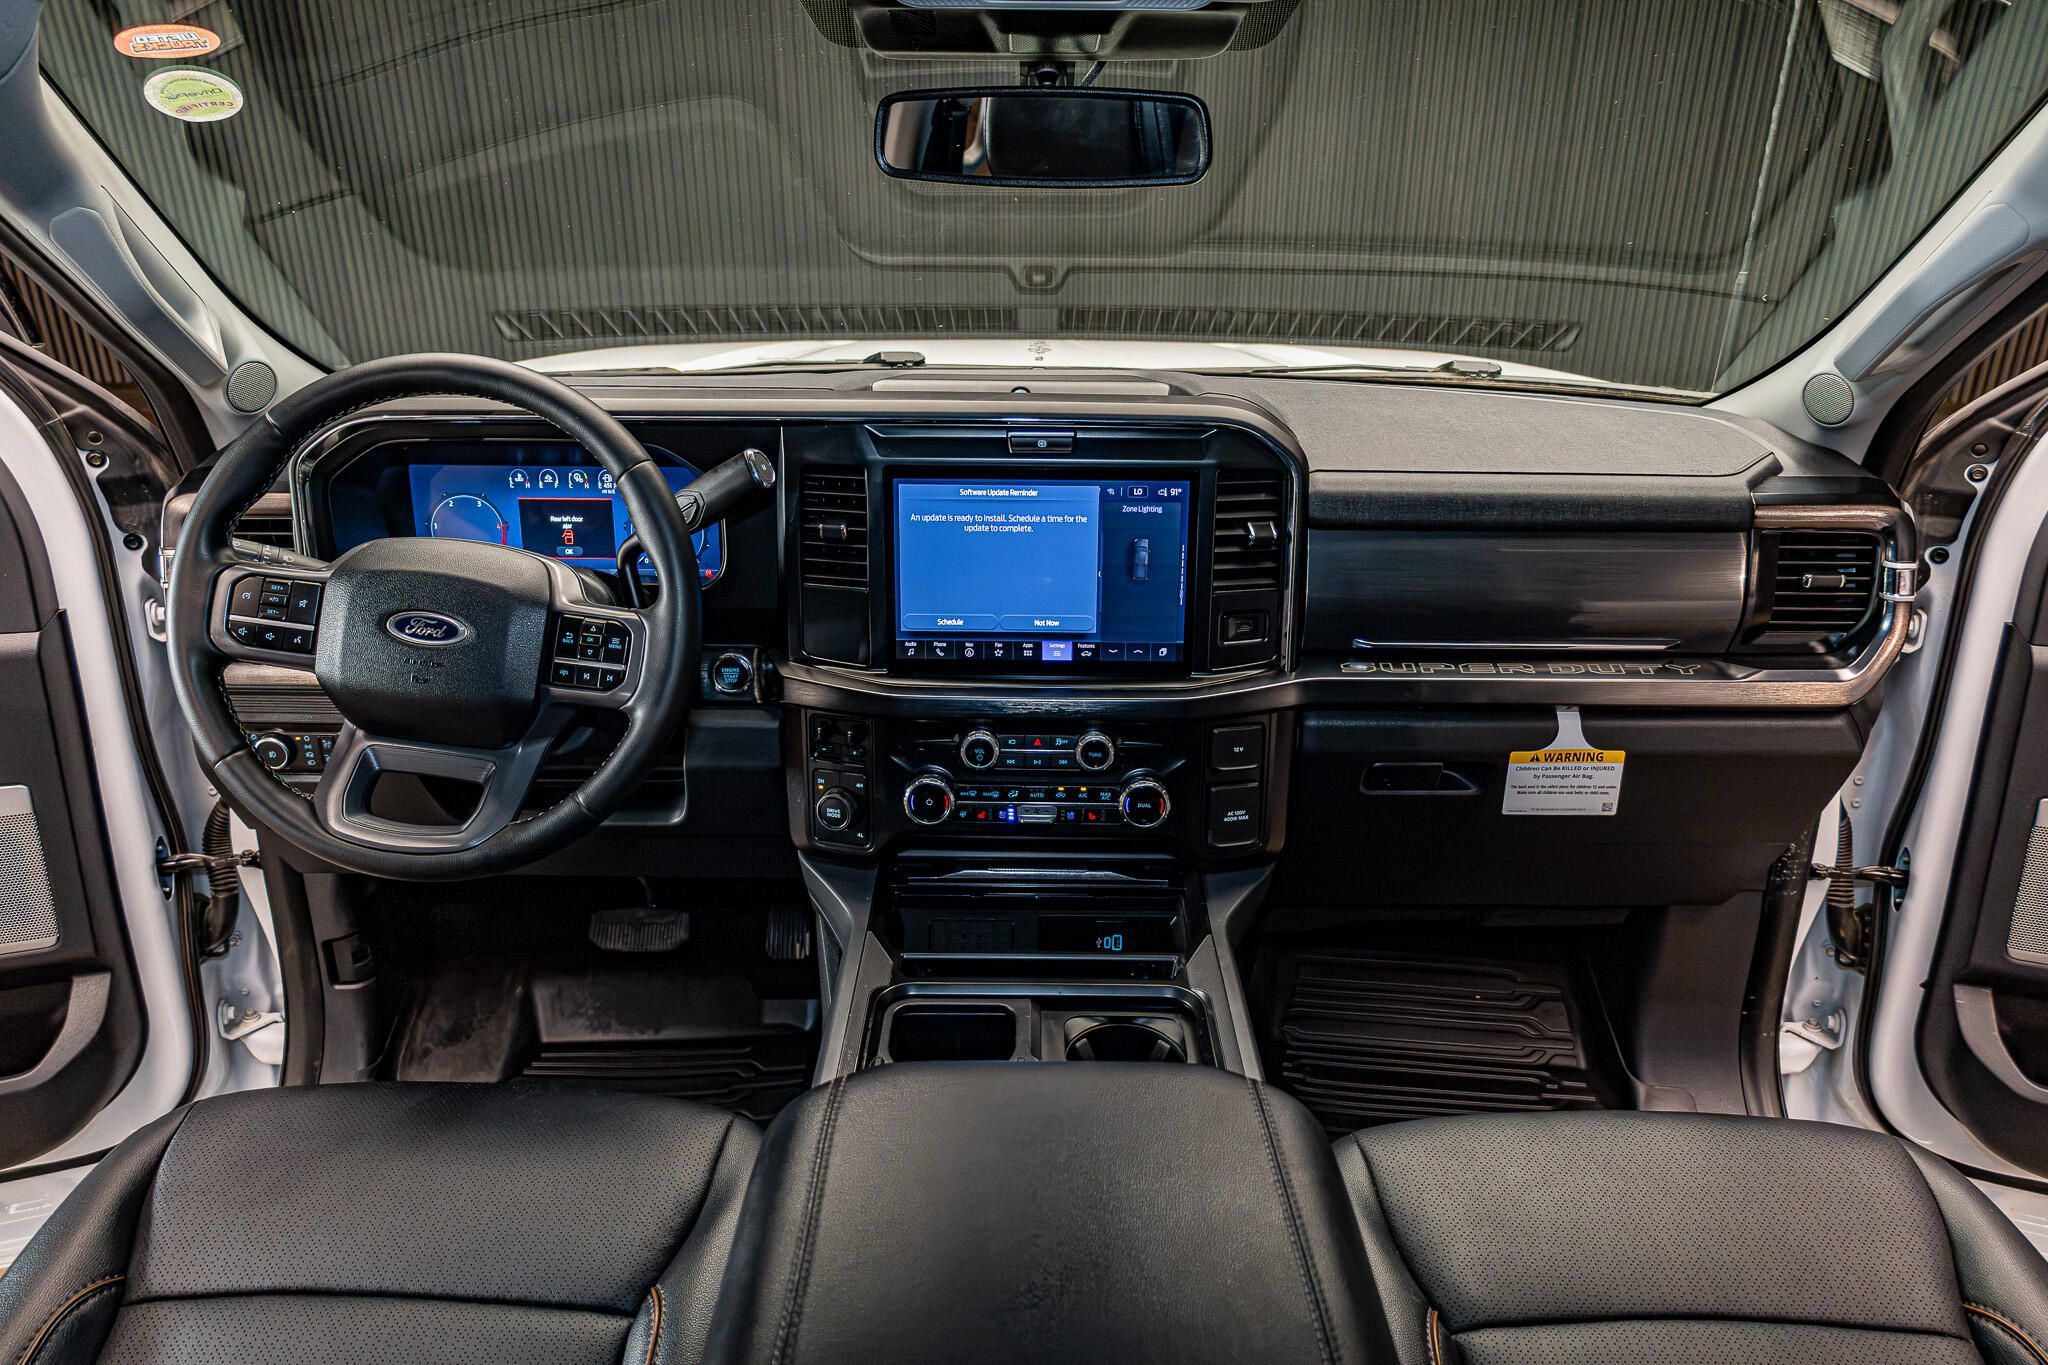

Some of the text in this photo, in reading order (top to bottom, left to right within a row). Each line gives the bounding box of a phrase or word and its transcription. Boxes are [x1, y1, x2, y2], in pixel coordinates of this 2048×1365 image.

[959, 488, 1038, 497] Software Update Reminder
[1170, 488, 1182, 496] 91°
[1122, 505, 1163, 513] Zone Lighting
[910, 513, 921, 521] An
[921, 513, 947, 523] update
[947, 514, 953, 522] is
[954, 514, 974, 523] ready
[983, 514, 1007, 522] install.
[1008, 514, 1041, 522] Schedule
[1064, 515, 1075, 523] for
[1075, 515, 1088, 523] the
[964, 524, 990, 533] update
[999, 524, 1034, 533] complete.
[937, 618, 964, 626] Schedule
[404, 617, 448, 638] Ford
[1340, 662, 1701, 675] SUPER DUTY
[1543, 752, 1604, 762] WARNING
